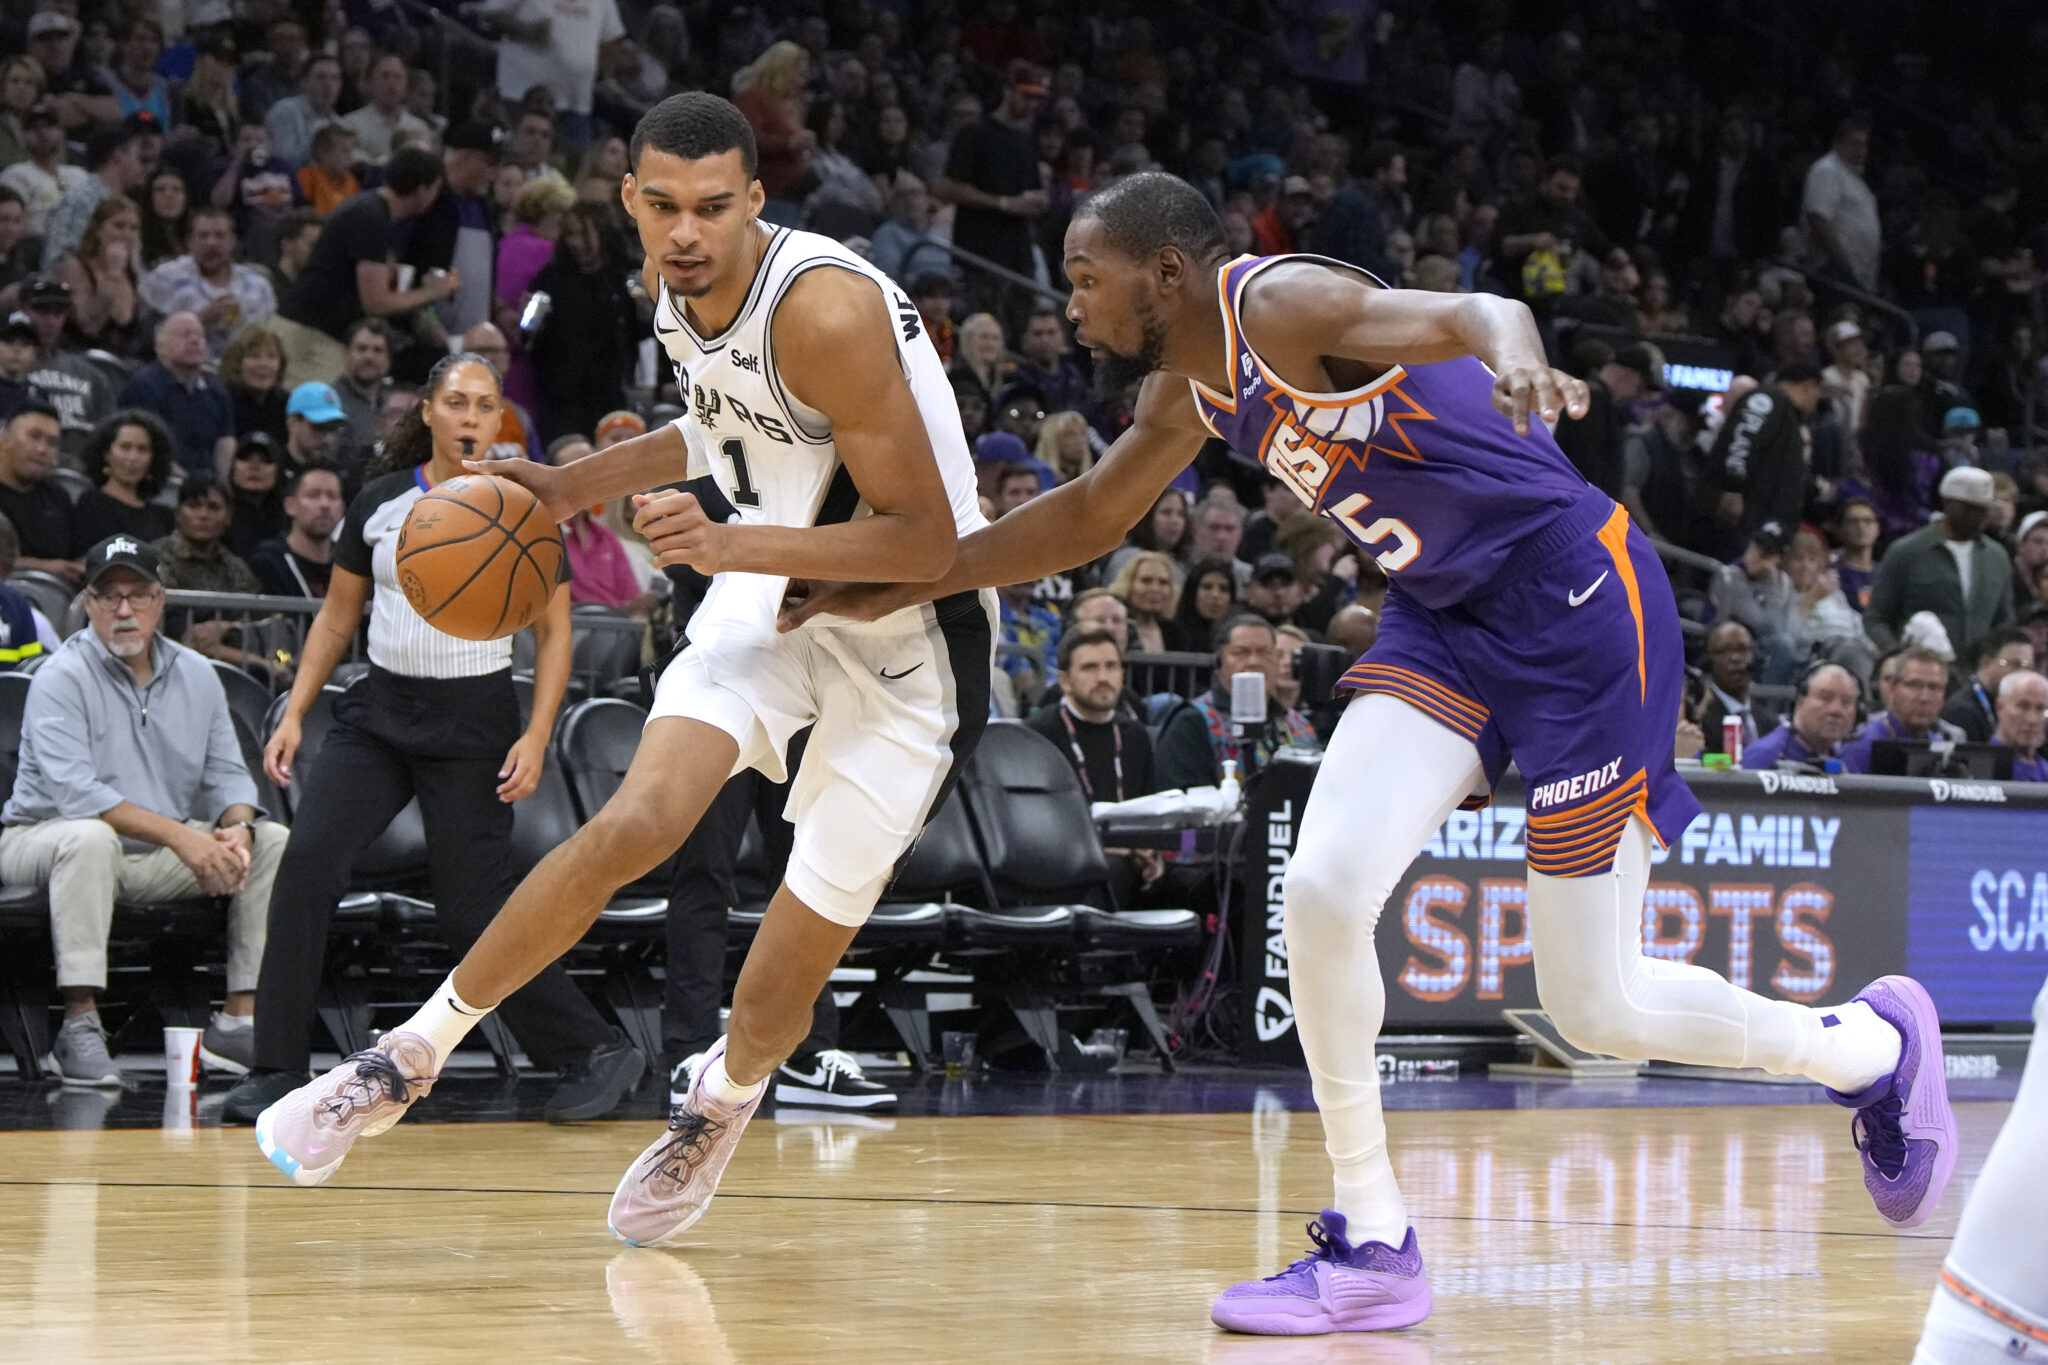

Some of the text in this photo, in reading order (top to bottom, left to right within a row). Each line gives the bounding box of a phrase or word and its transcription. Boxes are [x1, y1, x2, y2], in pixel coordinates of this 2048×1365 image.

[731, 349, 761, 374] Self.
[718, 436, 762, 510] 1
[1320, 492, 1422, 573] 5
[1531, 755, 1623, 810] PHOENIX
[1681, 813, 1841, 868] FAMILY
[1265, 799, 1293, 979] FANDUEL
[1397, 874, 1836, 1003] SPRTS
